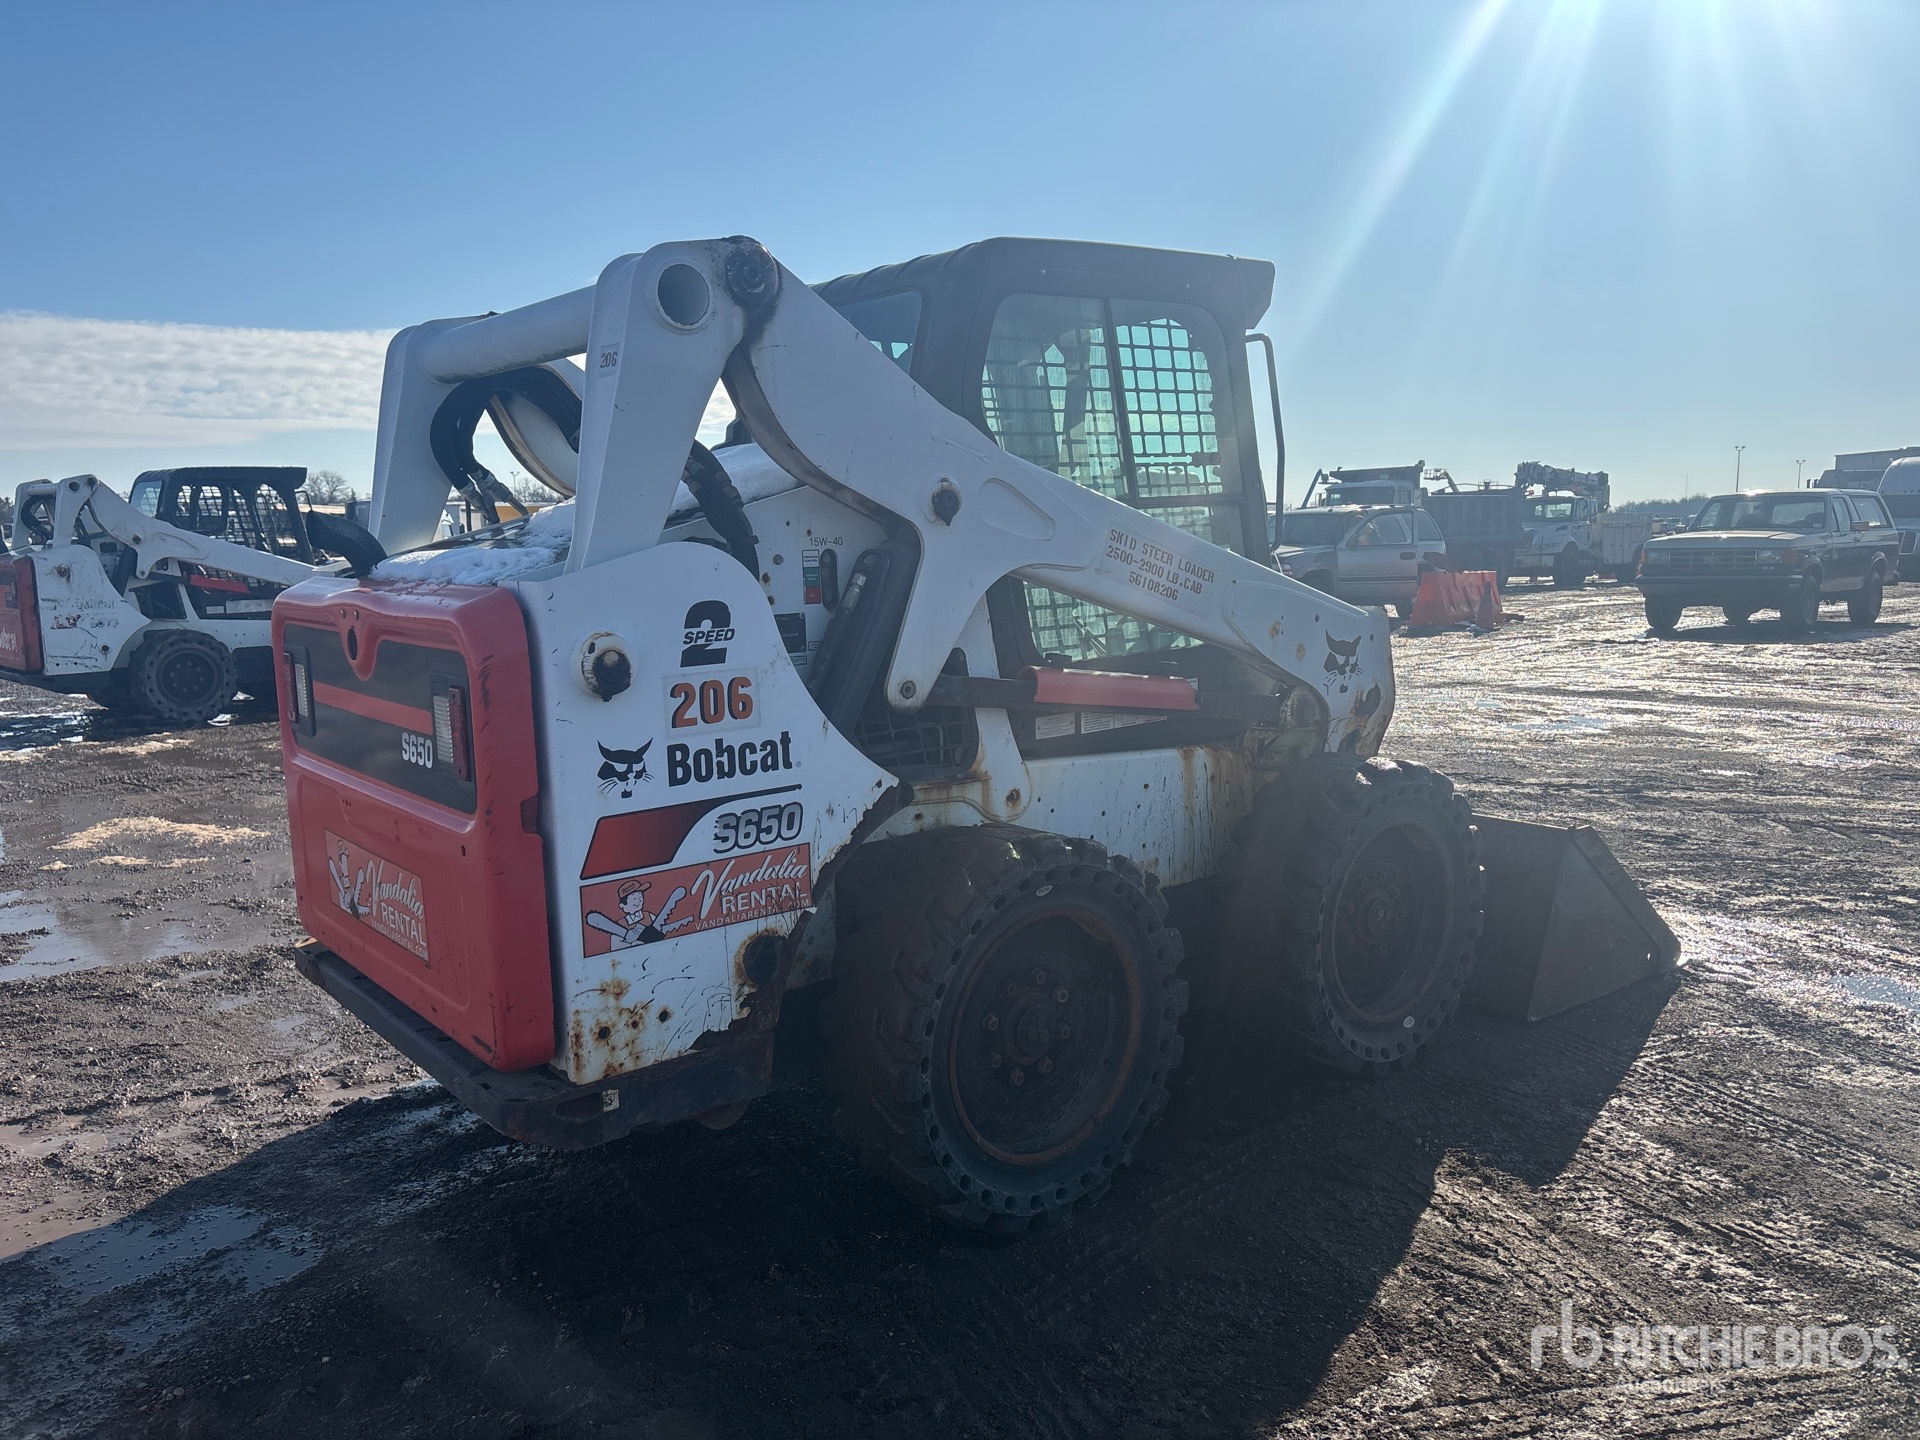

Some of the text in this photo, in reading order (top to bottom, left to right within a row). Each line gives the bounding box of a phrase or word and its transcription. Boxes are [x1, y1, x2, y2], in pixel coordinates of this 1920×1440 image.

[600, 351, 618, 369] 206
[809, 536, 844, 547] 15W-40
[1106, 544, 1165, 579] 2500-2900
[1109, 528, 1215, 584] SKID STEER LOADER
[1128, 570, 1179, 601] 56108206
[680, 600, 732, 668] 2
[683, 628, 735, 645] SPEED
[670, 676, 753, 729] 206
[402, 732, 433, 769] S650
[666, 731, 793, 787] Bobcat
[713, 801, 803, 854] S650
[365, 859, 425, 919] Vandalia
[690, 849, 808, 920] Vandalia
[721, 881, 808, 915] RENTAL
[381, 902, 427, 947] RENTAL
[695, 899, 810, 931] VANDALIARENTA.COM
